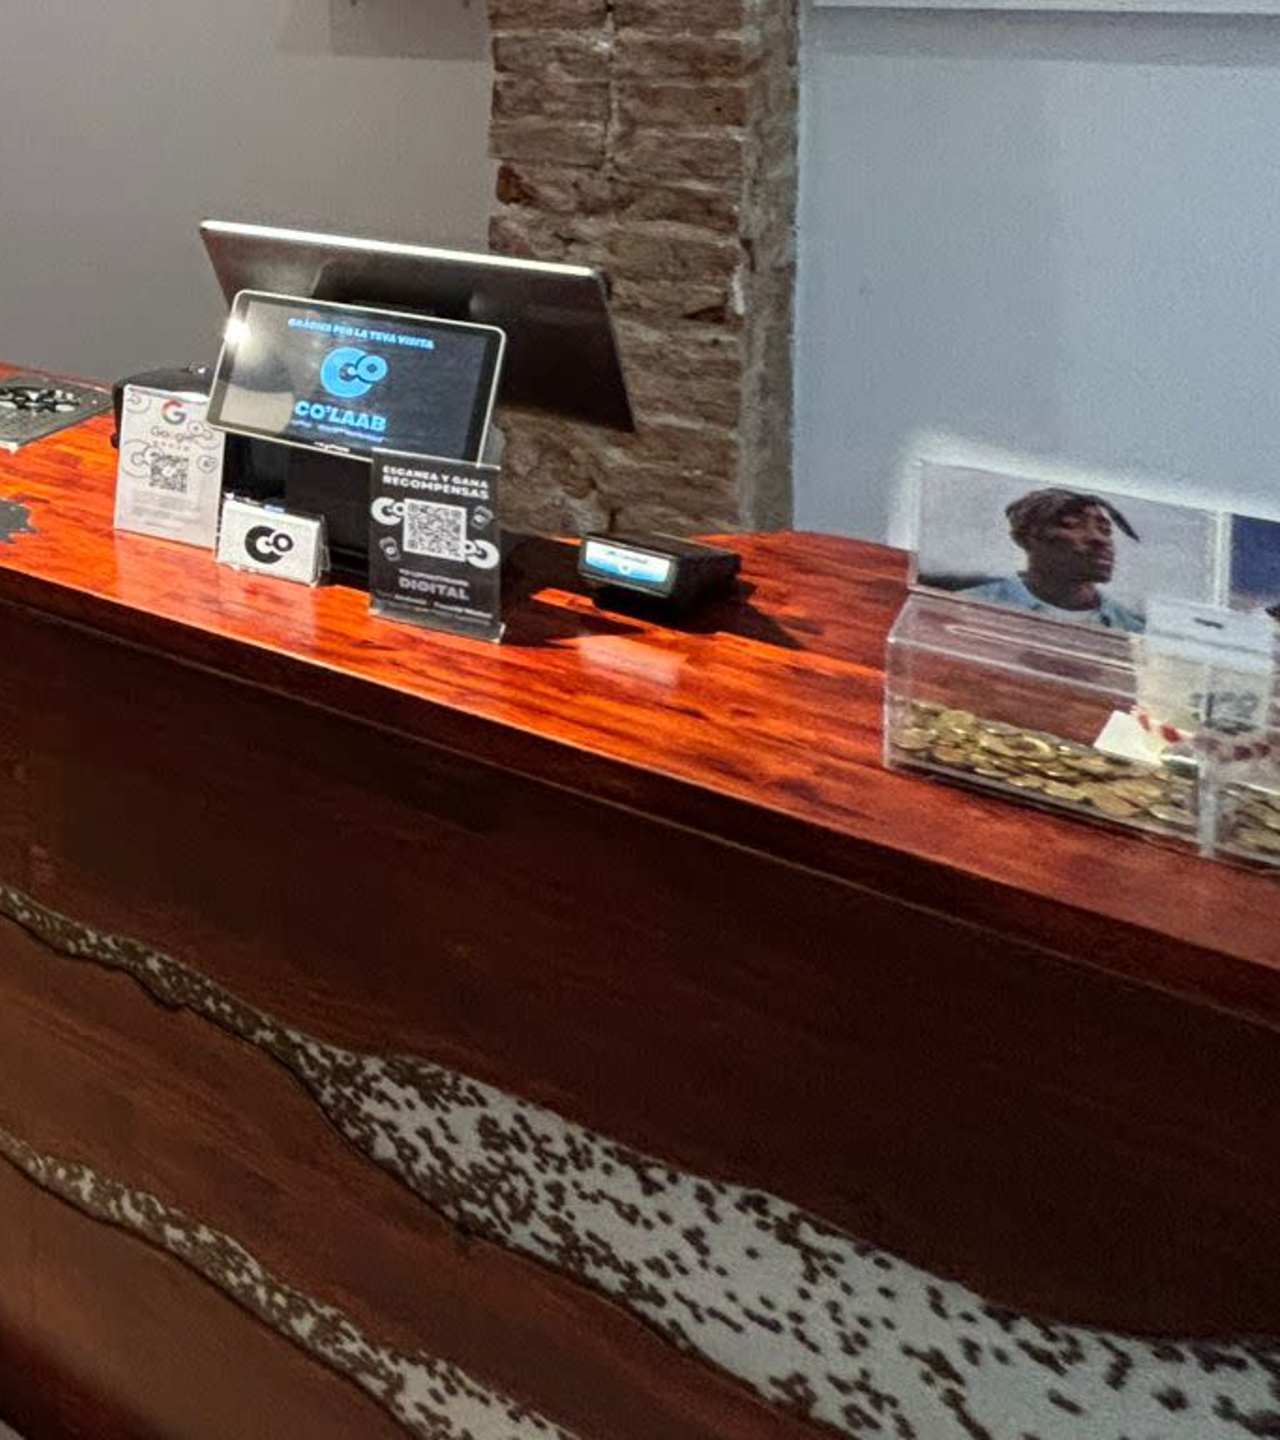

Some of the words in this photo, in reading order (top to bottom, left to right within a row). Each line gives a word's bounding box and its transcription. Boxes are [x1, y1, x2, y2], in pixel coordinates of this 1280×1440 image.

[294, 400, 387, 432] CO'LAAB
[382, 474, 490, 500] RECOMPENSAS
[398, 576, 470, 601] DIGITAL
